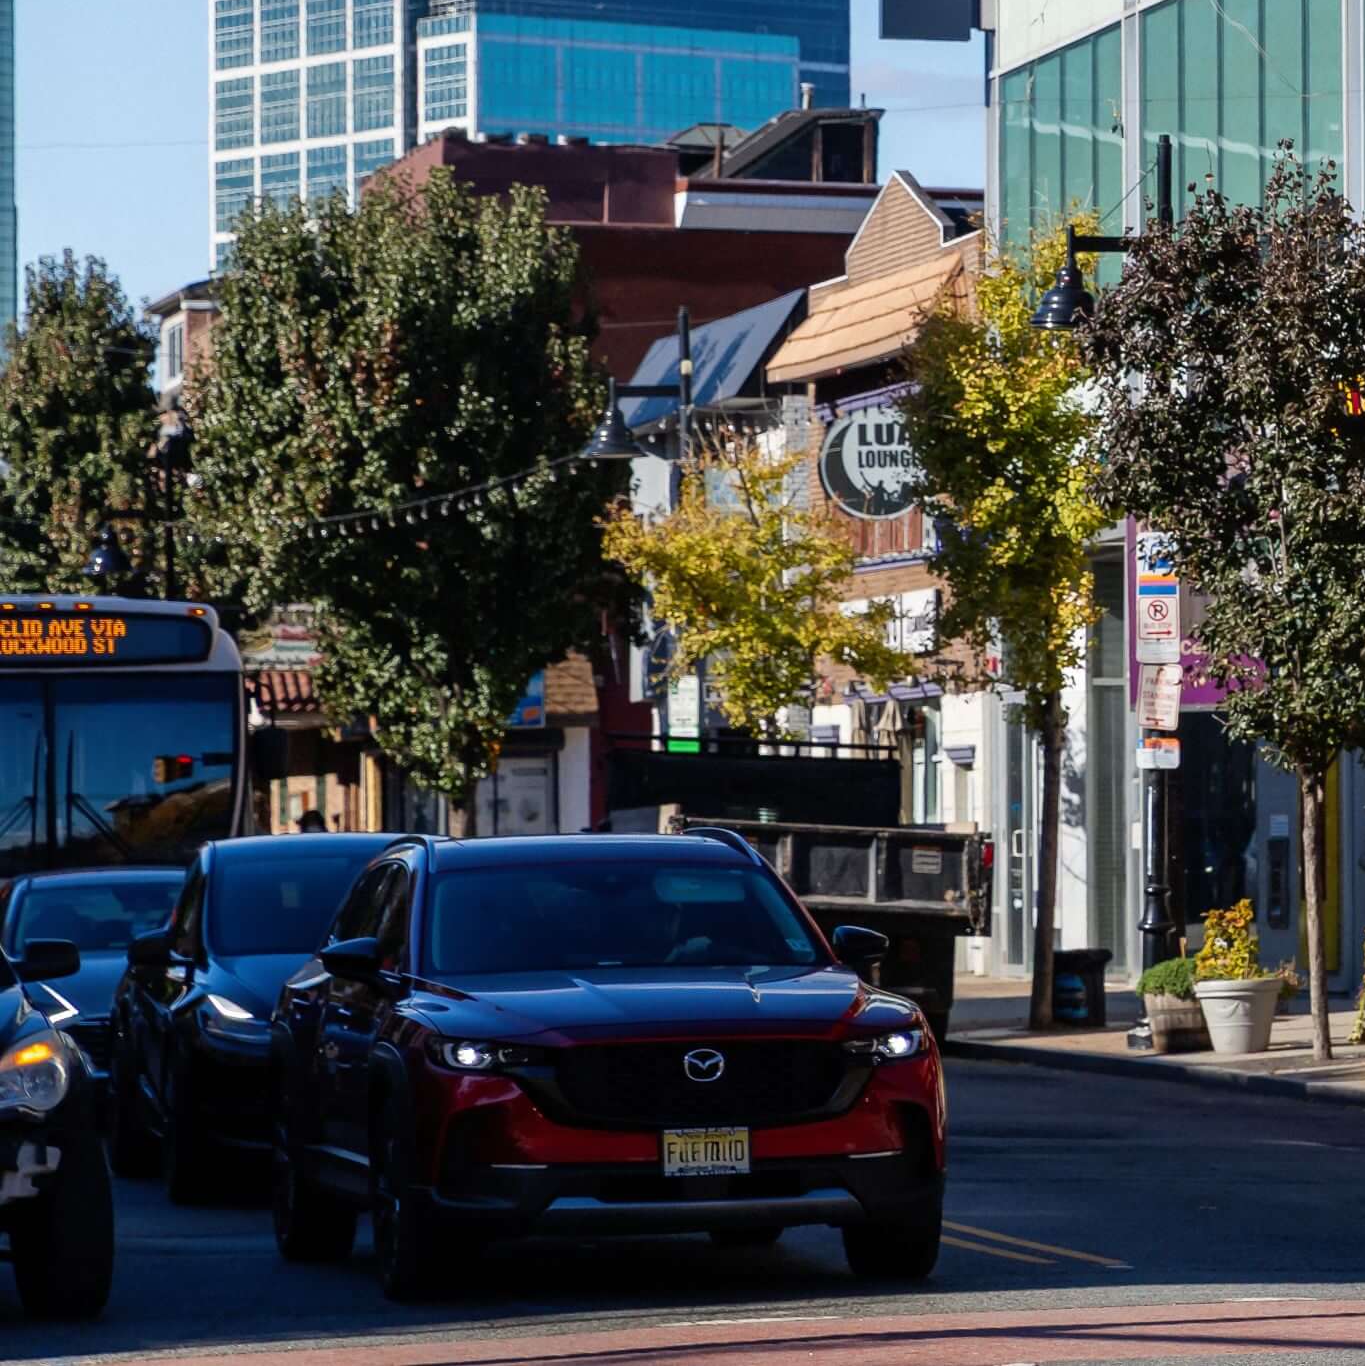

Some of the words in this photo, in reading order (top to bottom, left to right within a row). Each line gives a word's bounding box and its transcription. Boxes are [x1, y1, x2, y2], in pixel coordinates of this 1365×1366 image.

[49, 619, 86, 636] AVE
[90, 619, 127, 637] VIA
[93, 638, 116, 655] ST
